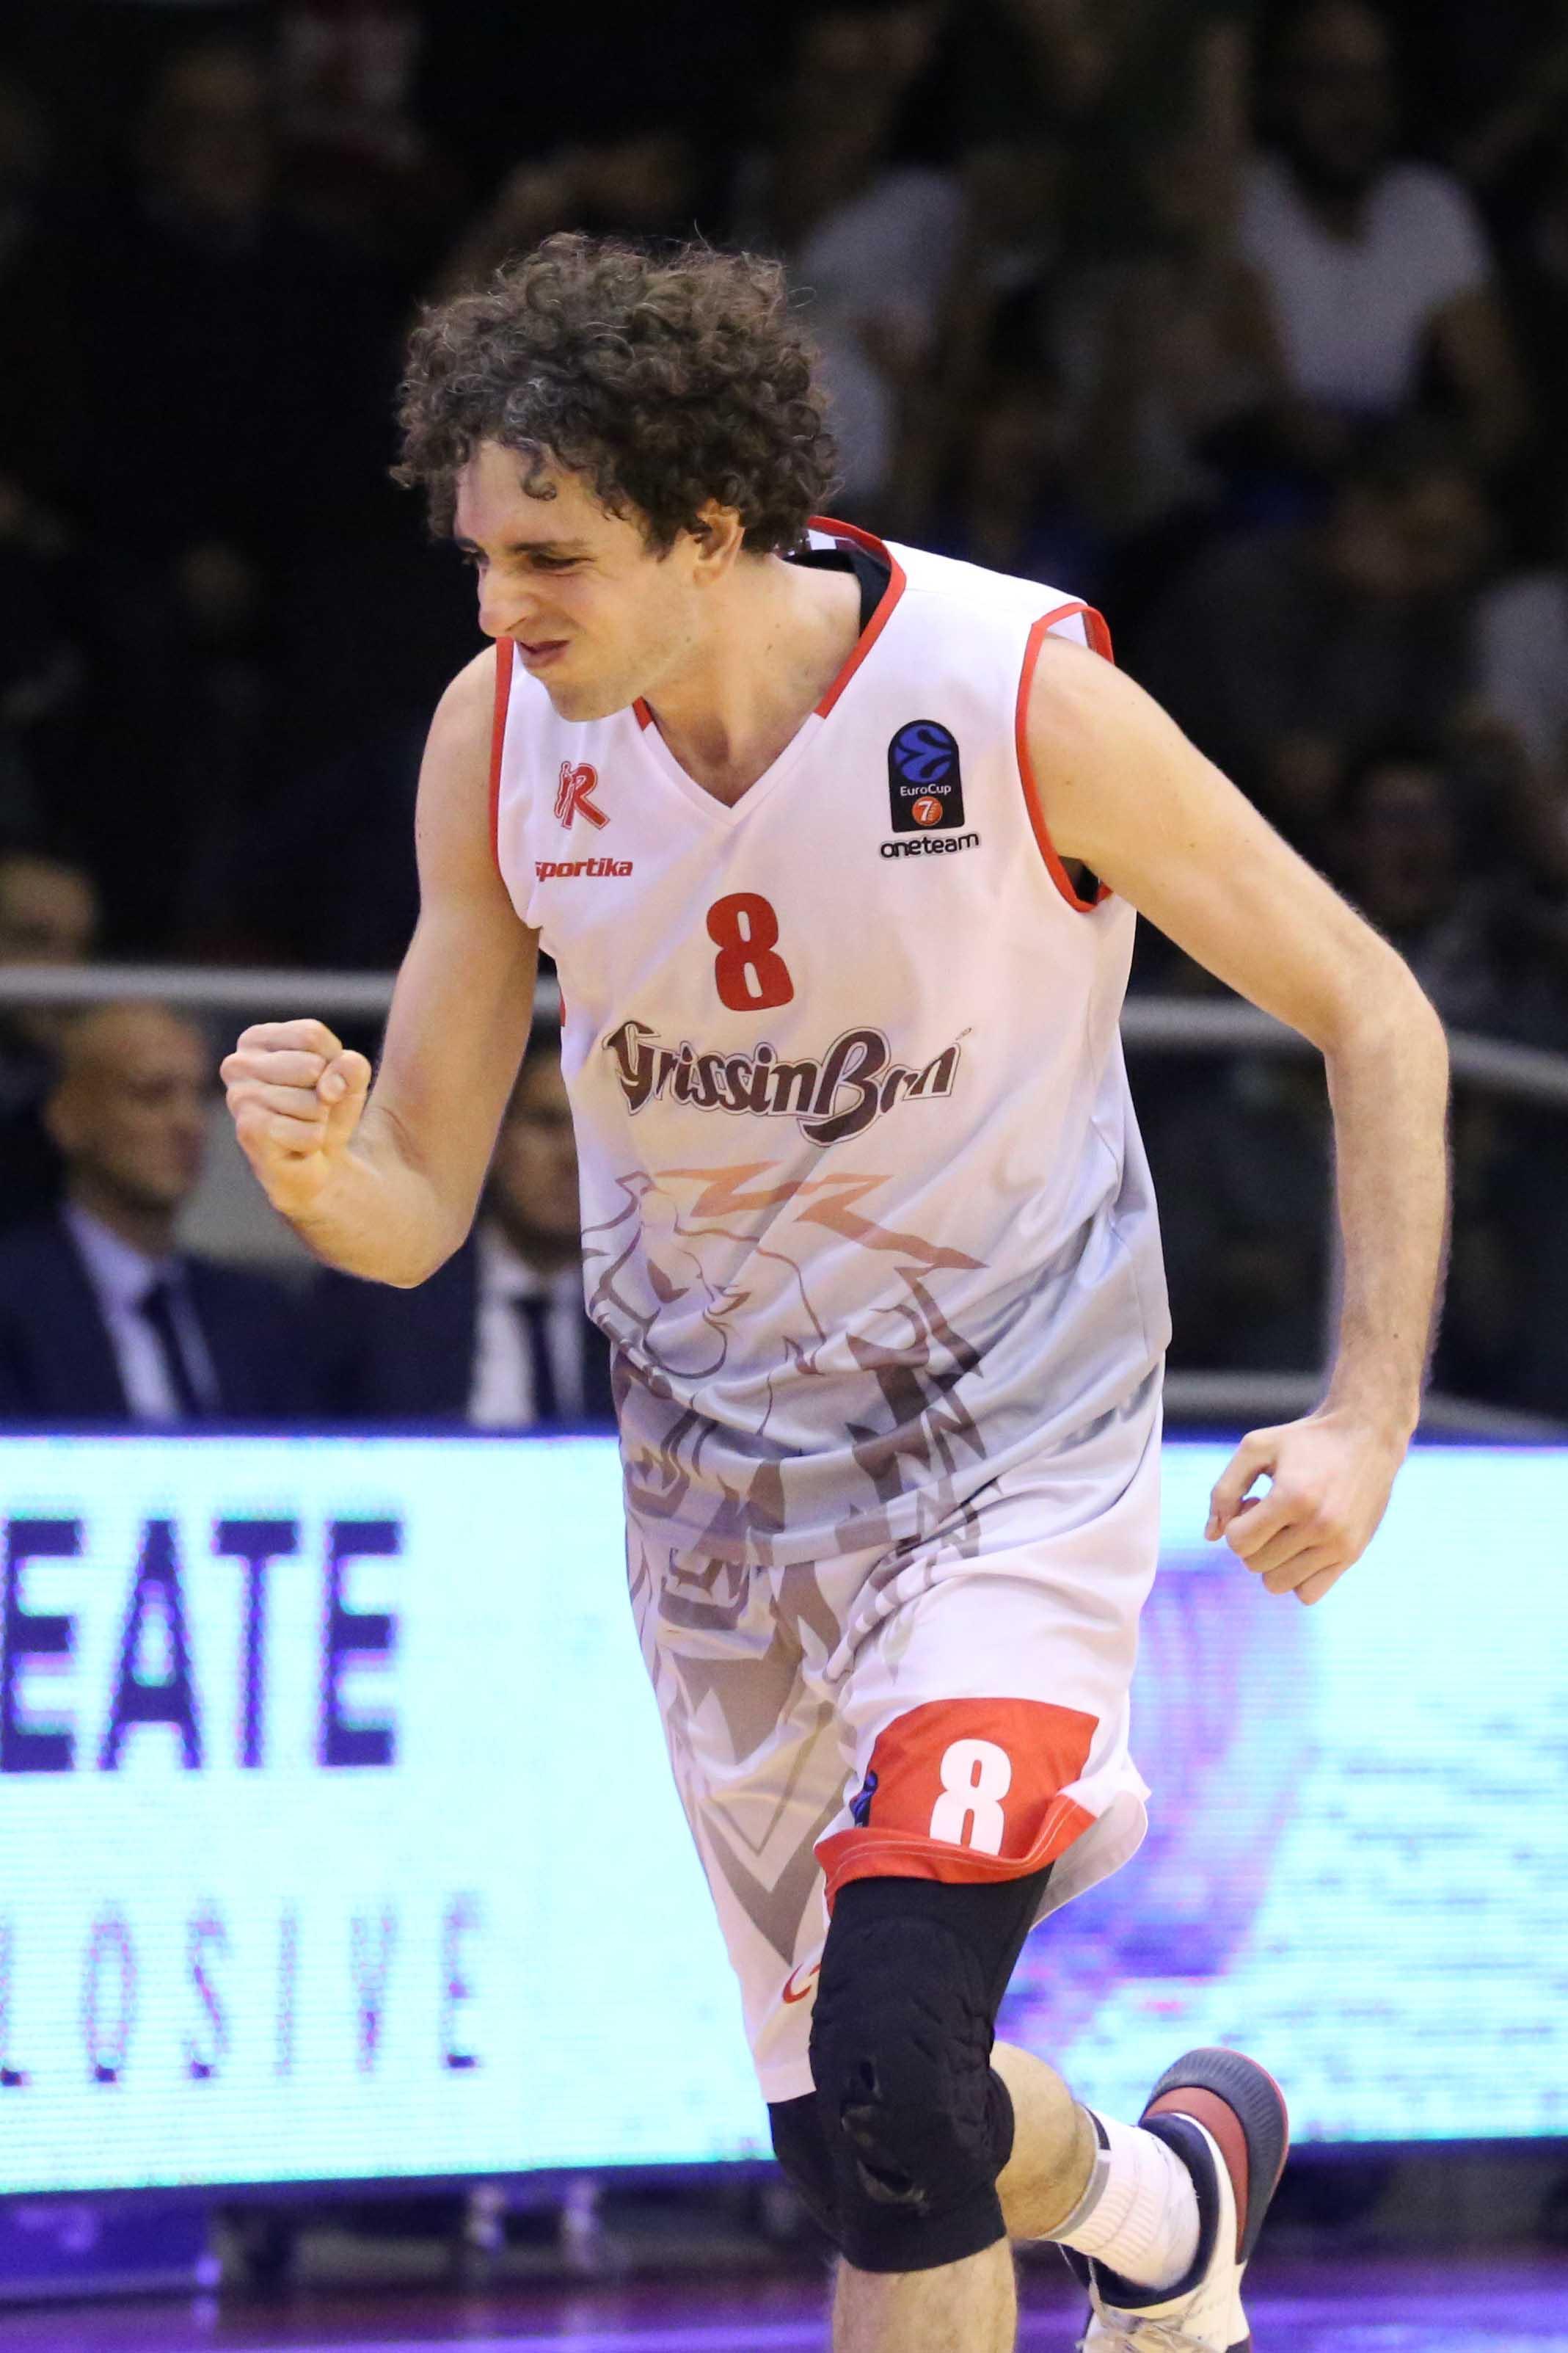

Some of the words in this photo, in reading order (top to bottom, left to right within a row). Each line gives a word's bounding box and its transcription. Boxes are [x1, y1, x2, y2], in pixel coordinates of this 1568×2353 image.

[900, 783, 952, 796] EuroCup
[918, 800, 933, 822] 7
[880, 833, 980, 858] oneteam
[707, 892, 795, 1011] 8
[0, 1516, 405, 1773] EATE
[930, 1739, 1012, 1855] 8
